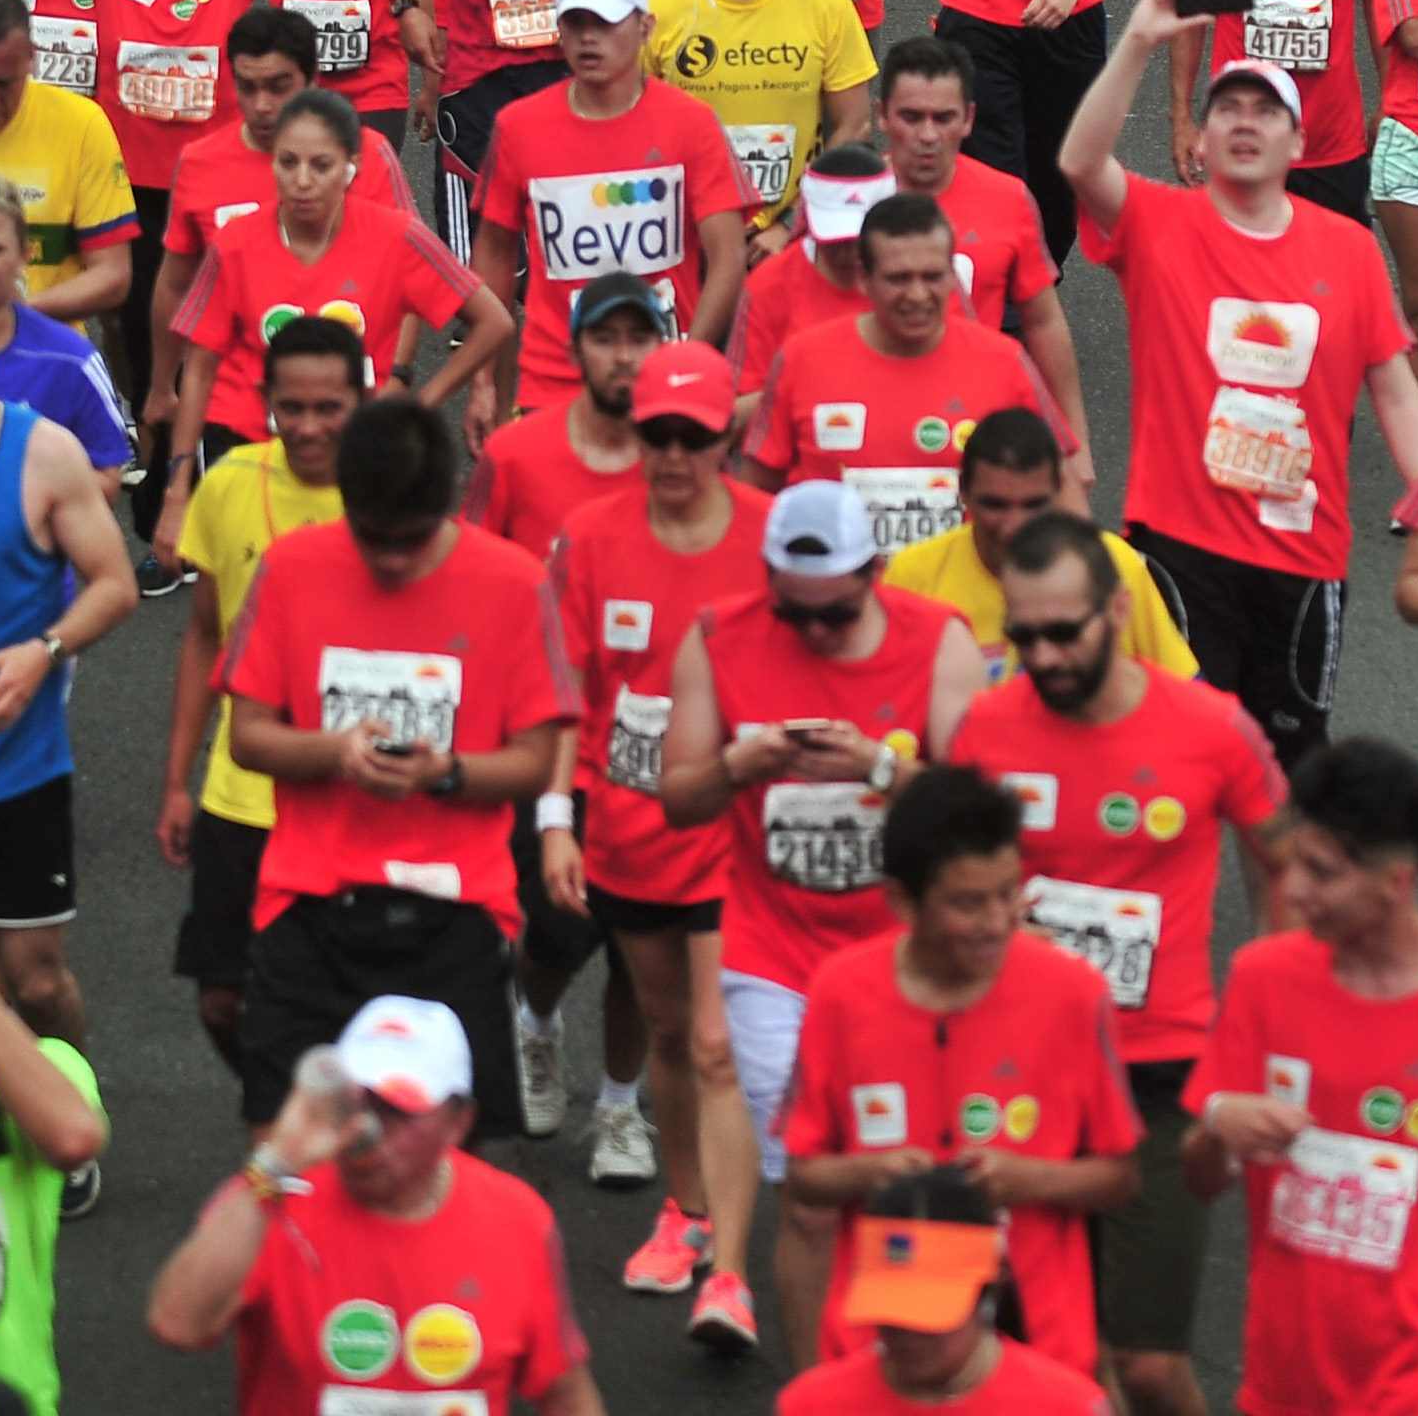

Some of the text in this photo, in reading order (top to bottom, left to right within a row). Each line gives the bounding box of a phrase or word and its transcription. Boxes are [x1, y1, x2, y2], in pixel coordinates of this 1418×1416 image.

[723, 40, 811, 73] efecty
[1249, 27, 1325, 58] 41755
[539, 178, 685, 269] Reval
[1220, 345, 1300, 370] porvenir
